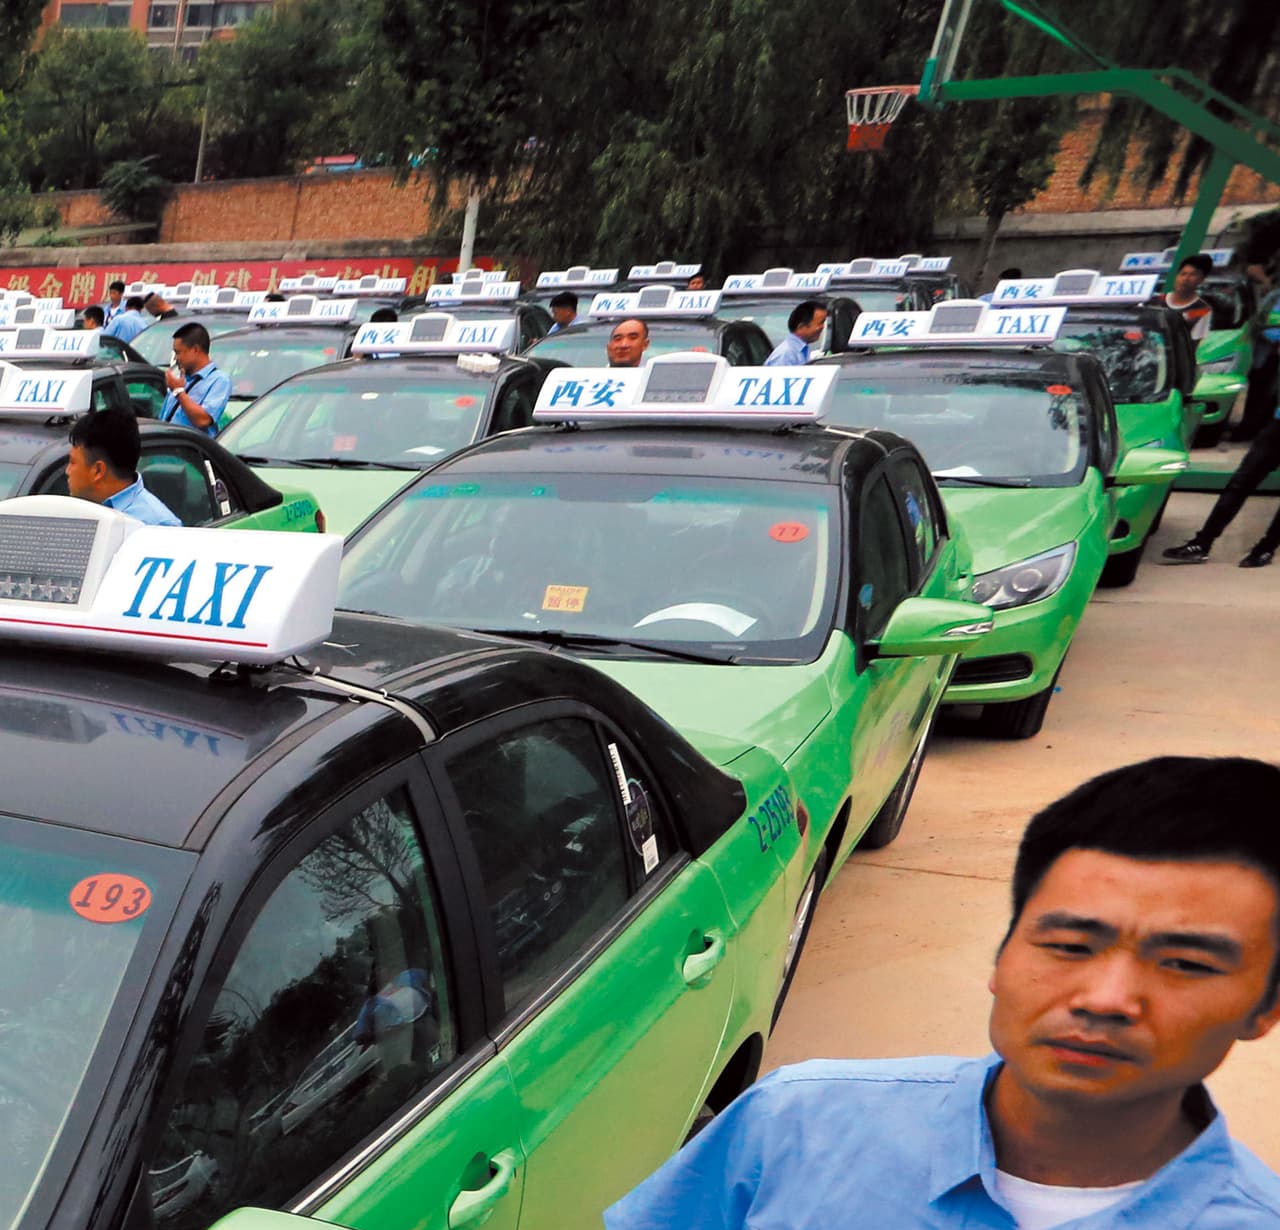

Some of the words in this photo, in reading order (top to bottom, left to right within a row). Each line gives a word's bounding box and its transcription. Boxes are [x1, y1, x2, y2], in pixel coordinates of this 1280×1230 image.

[796, 276, 823, 287] TAXI
[1104, 280, 1145, 295] TAXI
[489, 286, 511, 296] TAXI
[1001, 285, 1041, 299] 西安
[320, 304, 344, 315] TAXI
[597, 299, 627, 311] 西安
[679, 295, 711, 309] TAXI
[41, 315, 63, 325] TAXI
[861, 319, 914, 336] 西安
[995, 315, 1049, 334] TAXI
[360, 329, 399, 344] 西安
[458, 325, 497, 343] TAXI
[52, 337, 82, 351] TAXI
[15, 380, 66, 403] TAXI
[550, 378, 624, 407] 西安
[736, 377, 813, 407] TAXI
[123, 556, 273, 630] TAXI
[75, 880, 146, 917] 193
